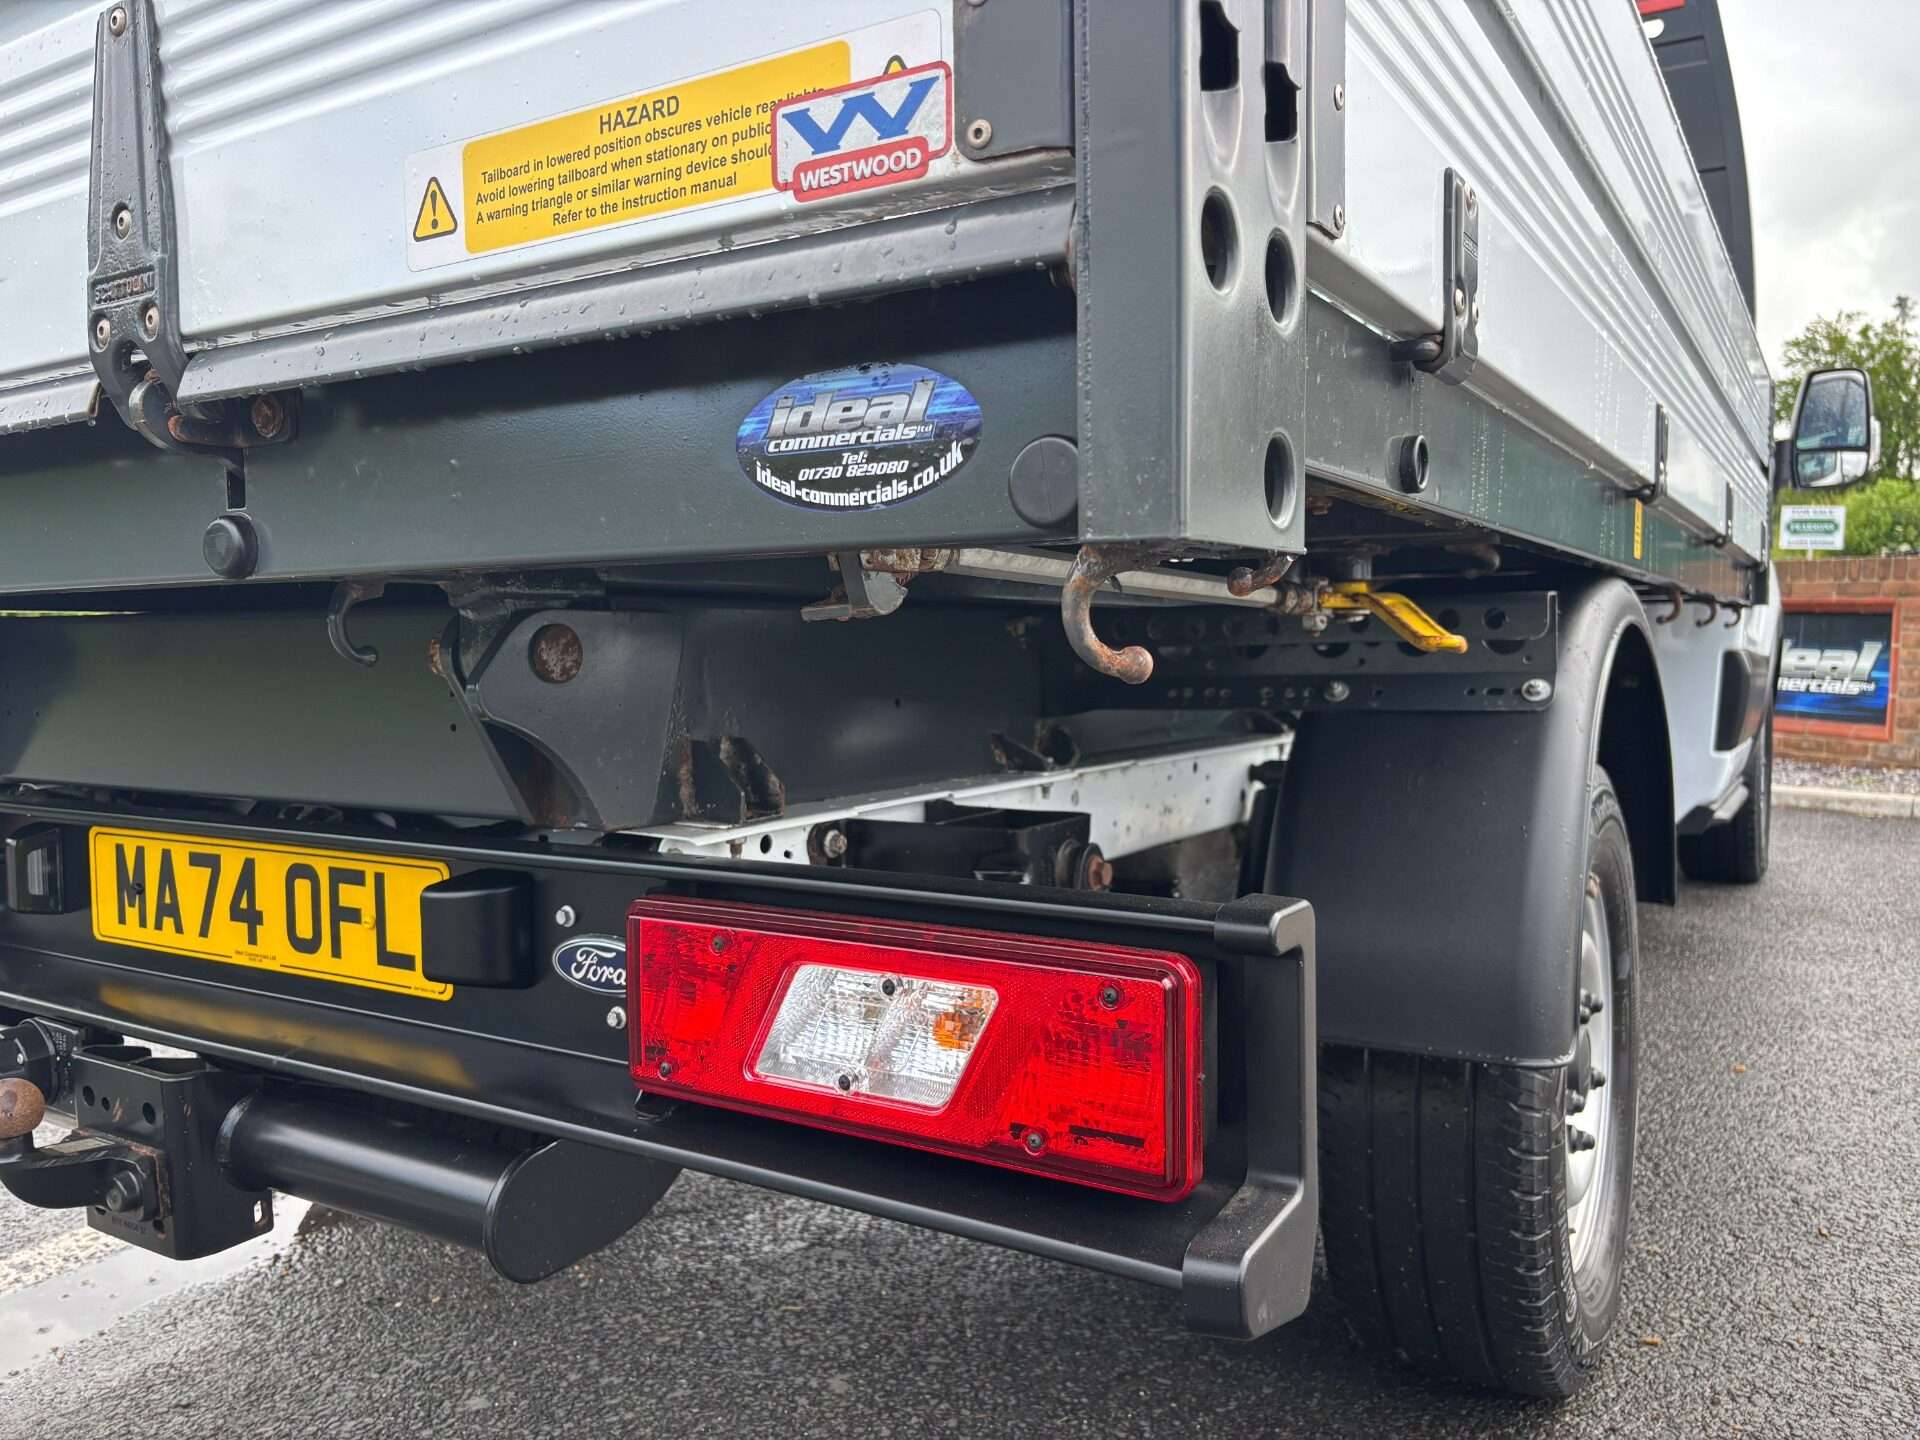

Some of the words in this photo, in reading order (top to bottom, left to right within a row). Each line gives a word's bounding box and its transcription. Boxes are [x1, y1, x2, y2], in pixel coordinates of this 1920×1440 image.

[600, 95, 680, 134] HAZARD
[476, 187, 505, 205] Avoid
[508, 177, 554, 198] lowering
[558, 161, 608, 186] tailboard
[611, 155, 642, 173] when
[646, 139, 707, 164] stationary
[711, 134, 728, 148] on
[732, 121, 772, 144] public
[481, 161, 530, 184] Tailboard
[534, 160, 543, 171] in
[546, 145, 590, 168] lowered
[594, 135, 641, 160] position
[645, 120, 701, 143] obscures
[706, 105, 751, 127] vehicle
[799, 148, 922, 192] WESTWOOD
[476, 211, 484, 225] A
[486, 203, 529, 222] warning
[531, 191, 573, 211] triangle
[576, 188, 588, 201] or
[591, 178, 631, 197] similar
[633, 166, 682, 187] warning
[686, 155, 727, 175] device
[552, 210, 582, 226] Refer
[585, 207, 597, 218] to
[600, 201, 618, 216] the
[622, 185, 687, 210] instruction
[690, 172, 737, 195] manual
[766, 378, 937, 439] ideal
[767, 423, 916, 453] commercials
[916, 423, 933, 434] ltd
[841, 451, 868, 466] Tel:
[755, 440, 964, 507] ideal-commercials.co.uk
[798, 468, 843, 482] 01730
[846, 460, 909, 478] 829080
[1780, 639, 1883, 680] eal
[114, 842, 264, 946] MA74
[285, 861, 416, 972] OFL
